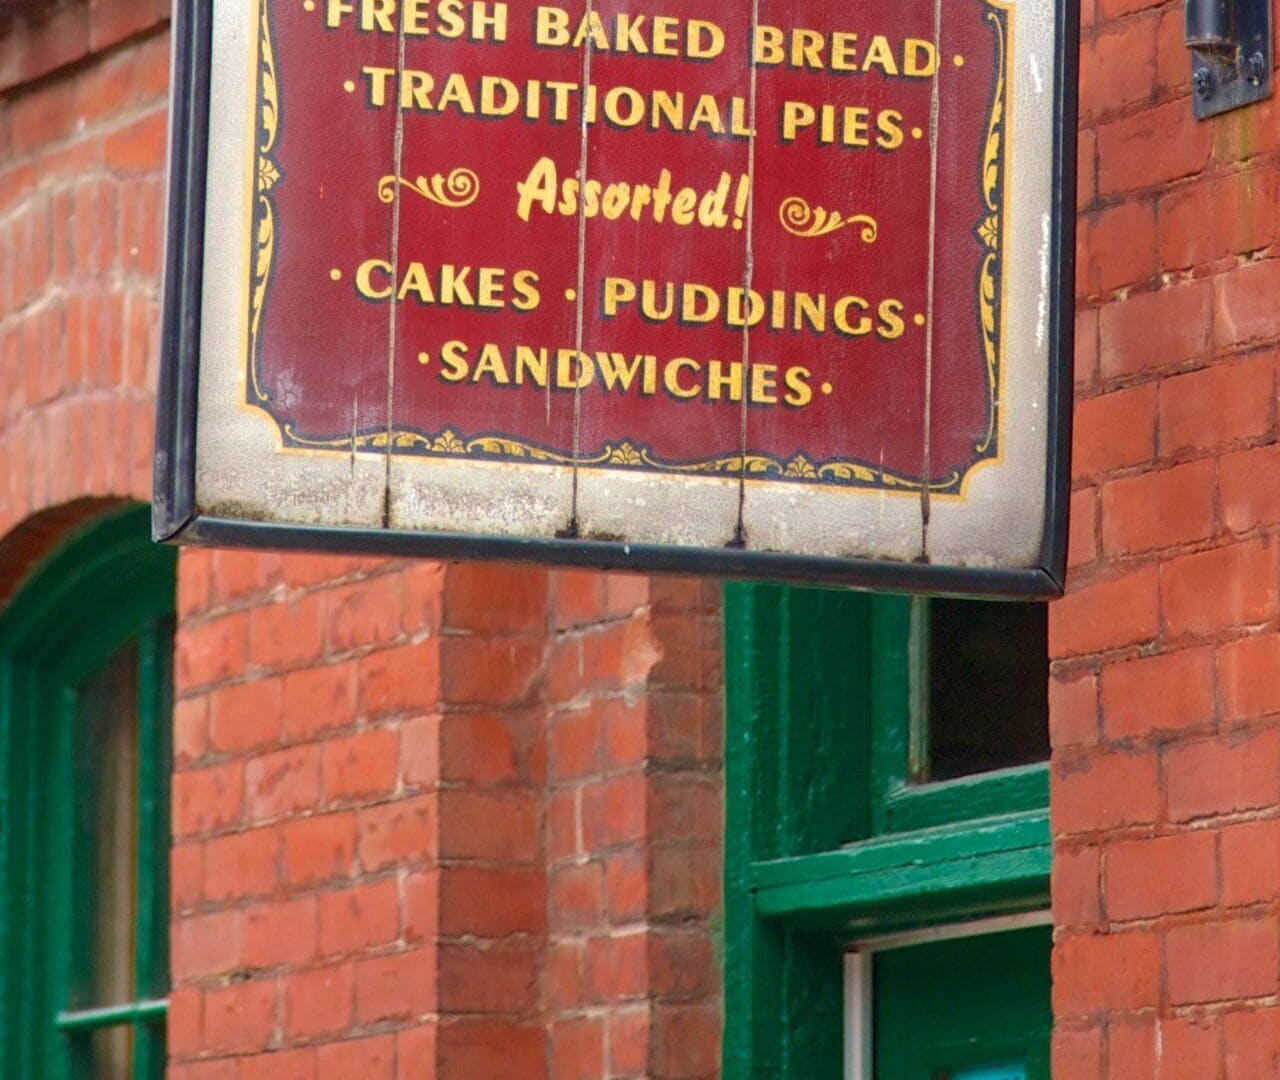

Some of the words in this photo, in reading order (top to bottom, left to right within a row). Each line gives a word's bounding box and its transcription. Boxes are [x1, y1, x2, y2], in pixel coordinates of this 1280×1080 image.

[535, 6, 726, 60] BAKED
[754, 23, 938, 78] BREAD
[361, 67, 755, 138] TRADITIONAL
[783, 102, 904, 149] PIES
[516, 156, 750, 231] Assorted!
[355, 258, 542, 311] CAKES
[603, 277, 904, 339] PUDDINGS
[439, 341, 813, 406] SANDWICHES
